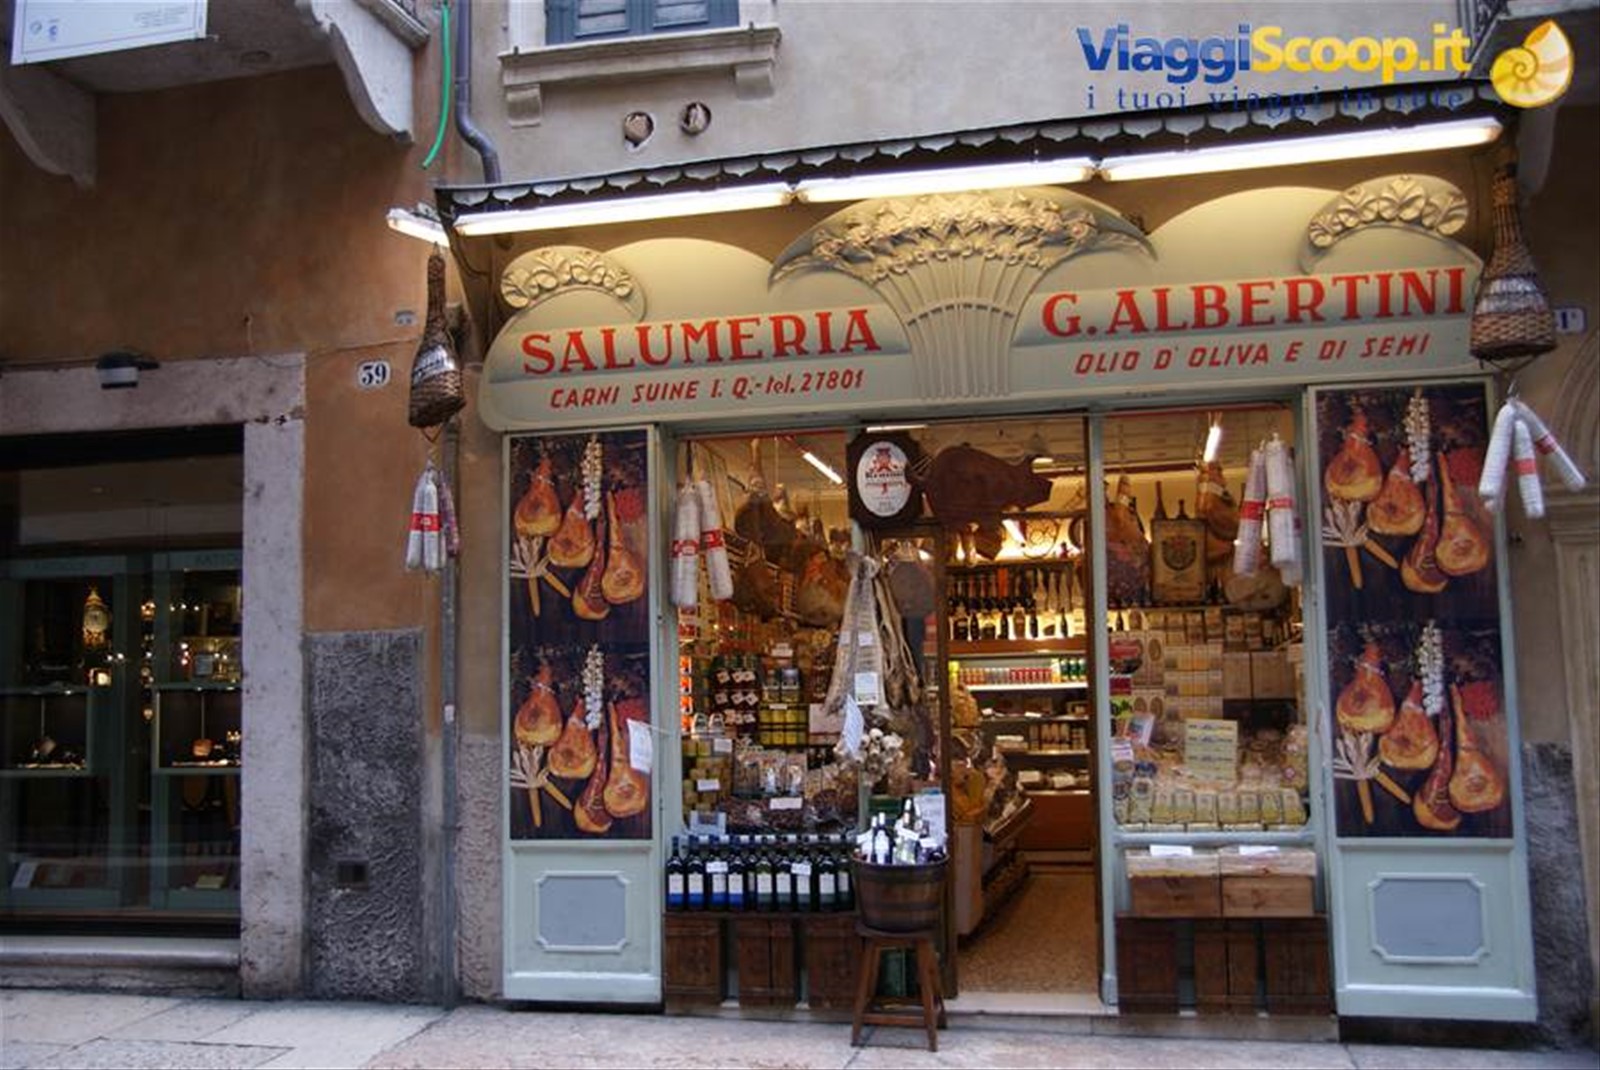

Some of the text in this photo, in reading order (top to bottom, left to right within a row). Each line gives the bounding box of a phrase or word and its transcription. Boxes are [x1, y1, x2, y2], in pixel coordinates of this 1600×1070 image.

[521, 309, 882, 376] SALUMERIA
[1075, 351, 1140, 375] OLIO
[1284, 341, 1303, 362] E
[1318, 339, 1347, 361] DI
[1360, 333, 1430, 358] SEMI
[550, 385, 620, 409] CARNI
[631, 380, 700, 403] SUINE
